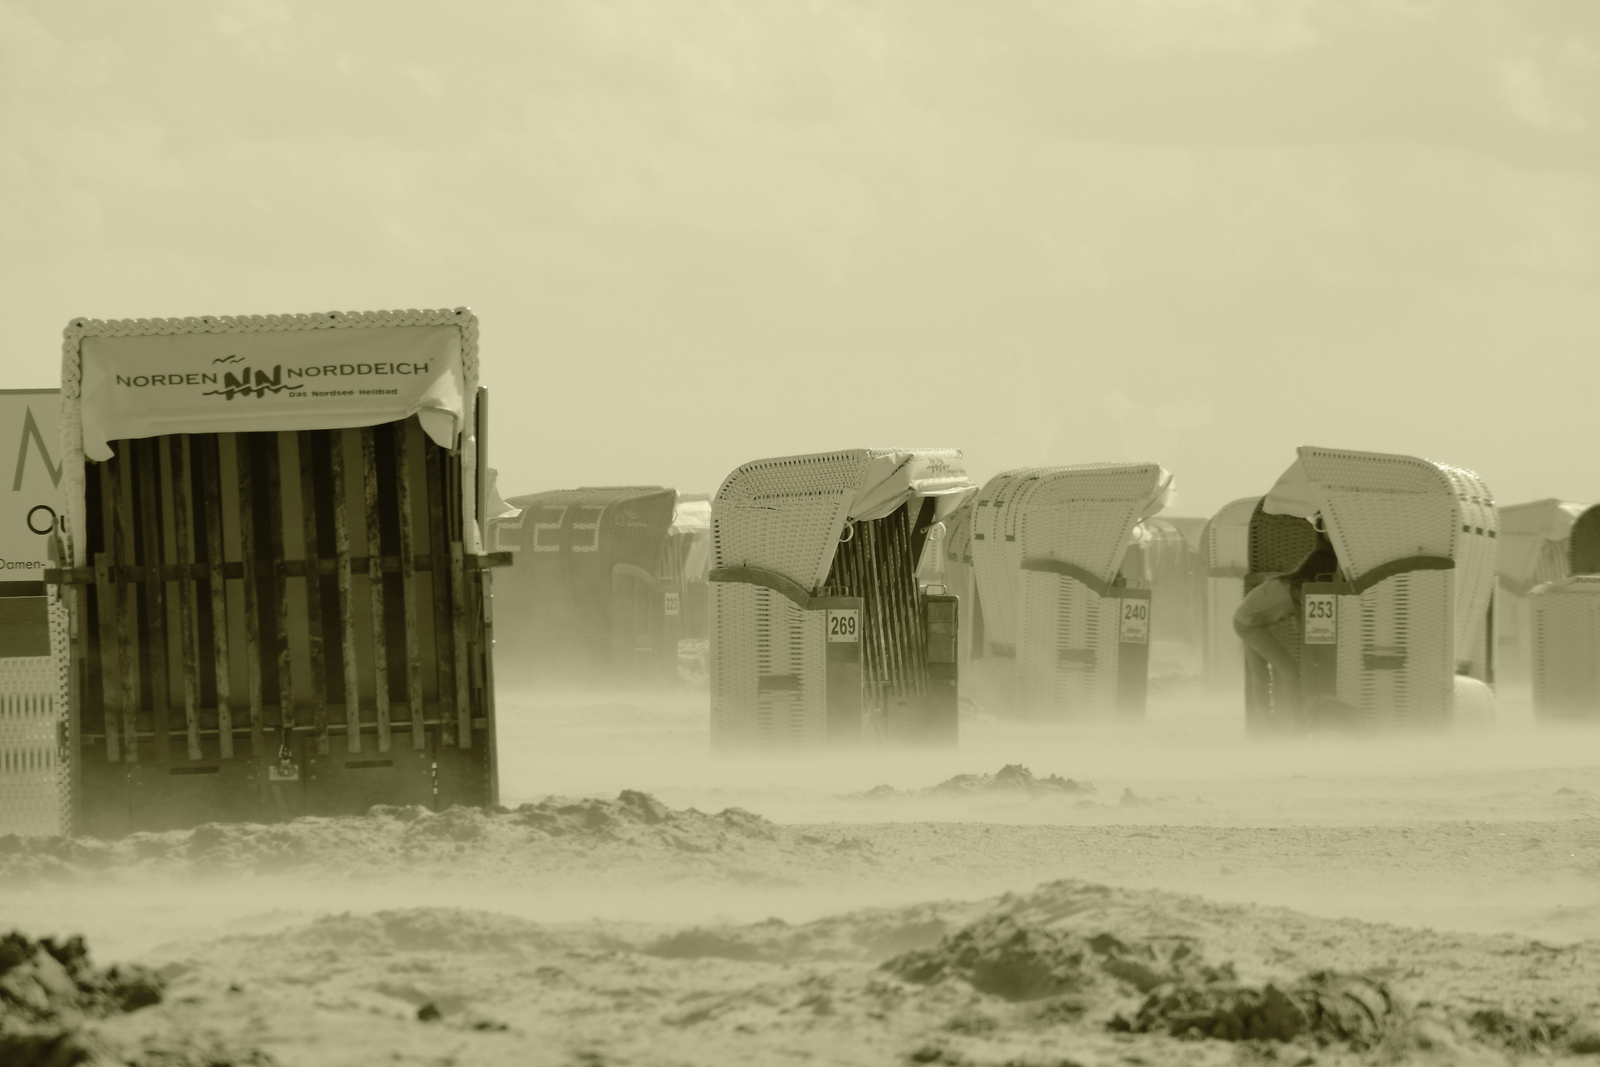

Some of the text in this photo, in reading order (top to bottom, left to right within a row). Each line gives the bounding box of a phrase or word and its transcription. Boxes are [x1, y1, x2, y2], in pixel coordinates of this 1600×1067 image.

[116, 373, 217, 387] NORDEN
[287, 362, 429, 378] NORDDEICH
[312, 389, 355, 397] Nordsee
[359, 388, 398, 396] Heilbad
[0, 558, 46, 570] Damen-
[1124, 604, 1147, 620] 240
[1308, 601, 1333, 618] 253
[830, 616, 856, 635] 269
